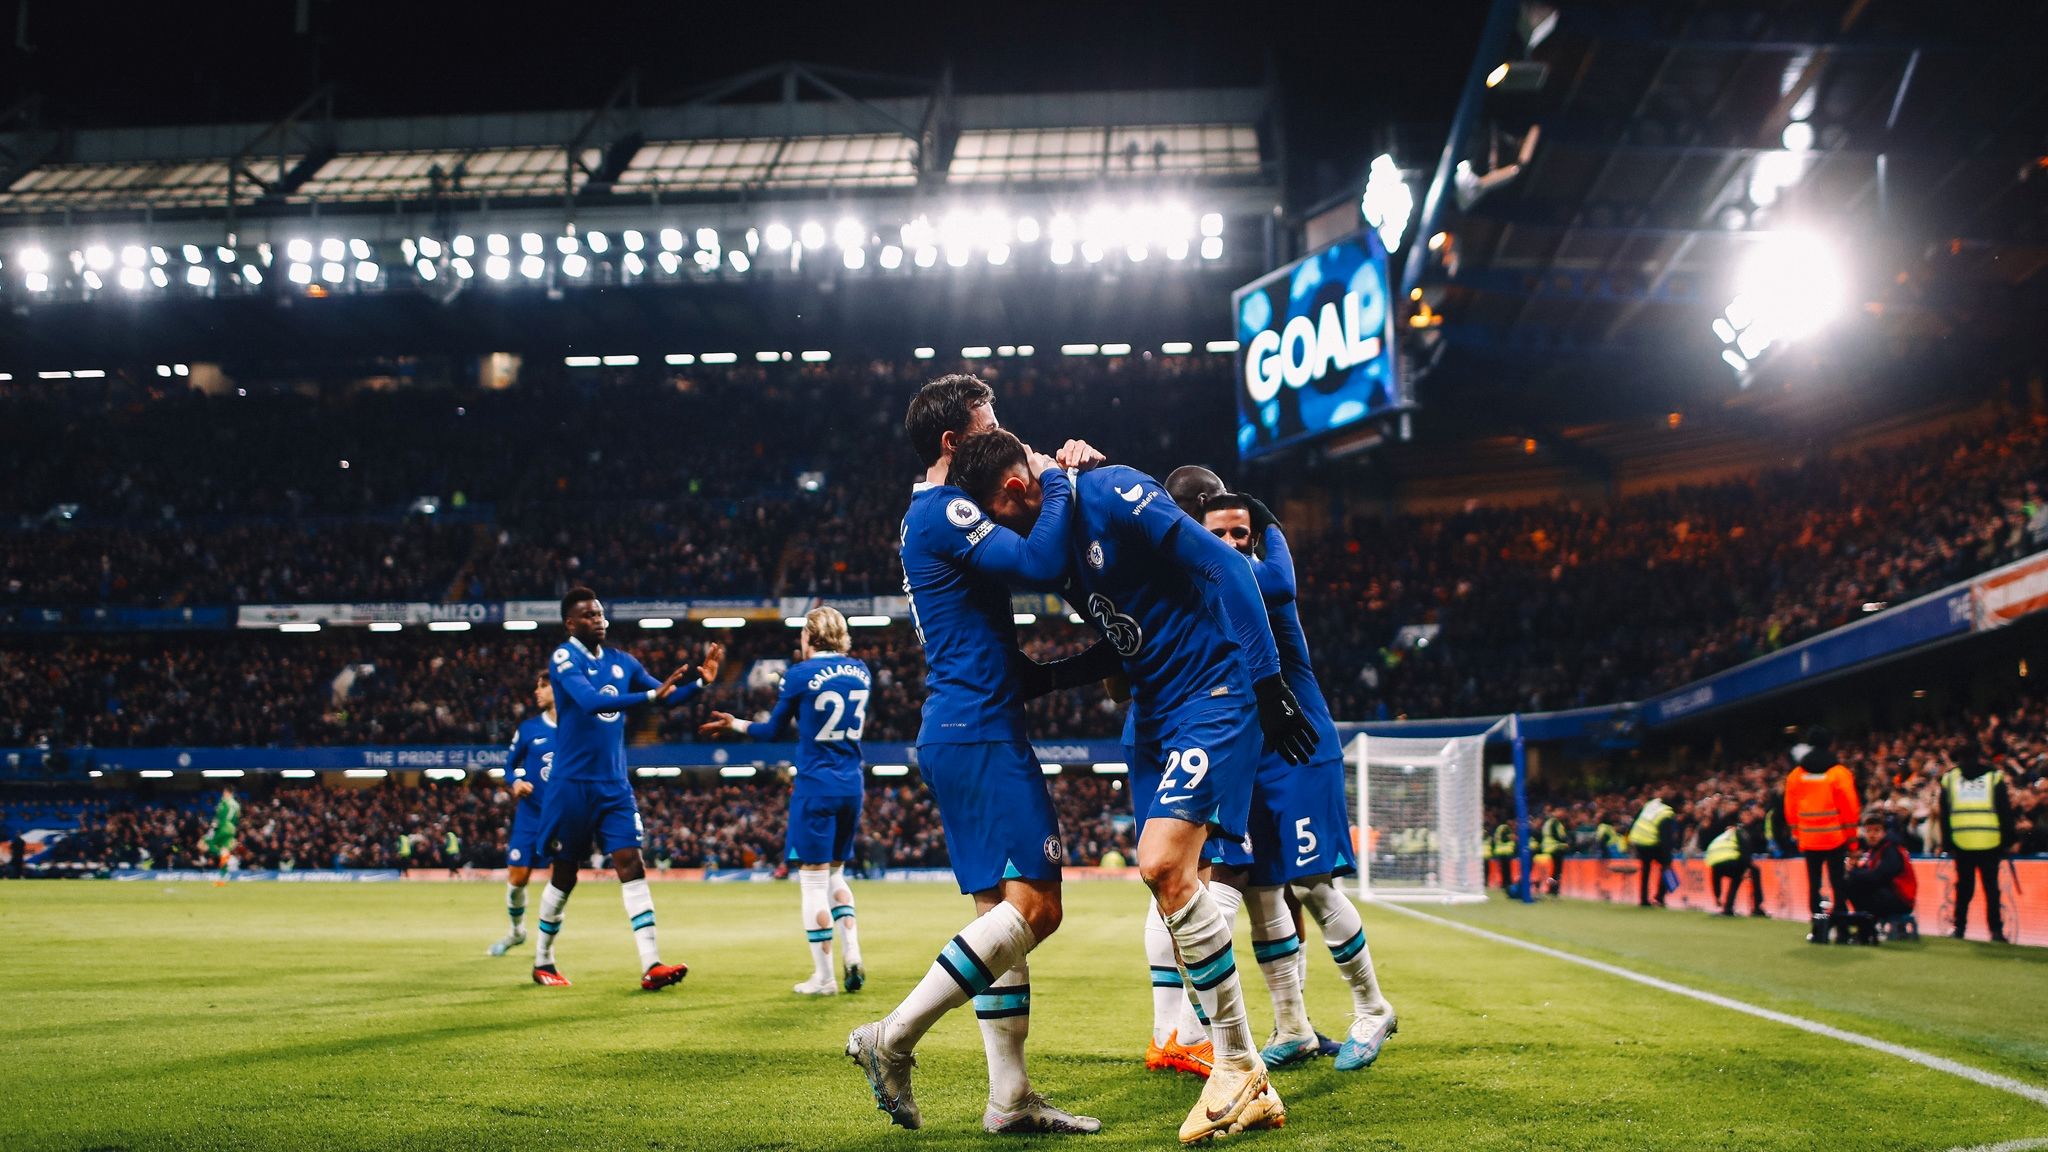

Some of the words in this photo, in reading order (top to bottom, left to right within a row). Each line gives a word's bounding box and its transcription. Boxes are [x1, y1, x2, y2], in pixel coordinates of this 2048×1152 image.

[1245, 290, 1380, 402] GOAL
[1132, 491, 1159, 516] WhaleFin
[814, 689, 870, 741] 23
[364, 751, 393, 766] THE
[397, 751, 445, 766] PRIDE
[1156, 747, 1209, 792] 29
[1295, 816, 1317, 854] 5
